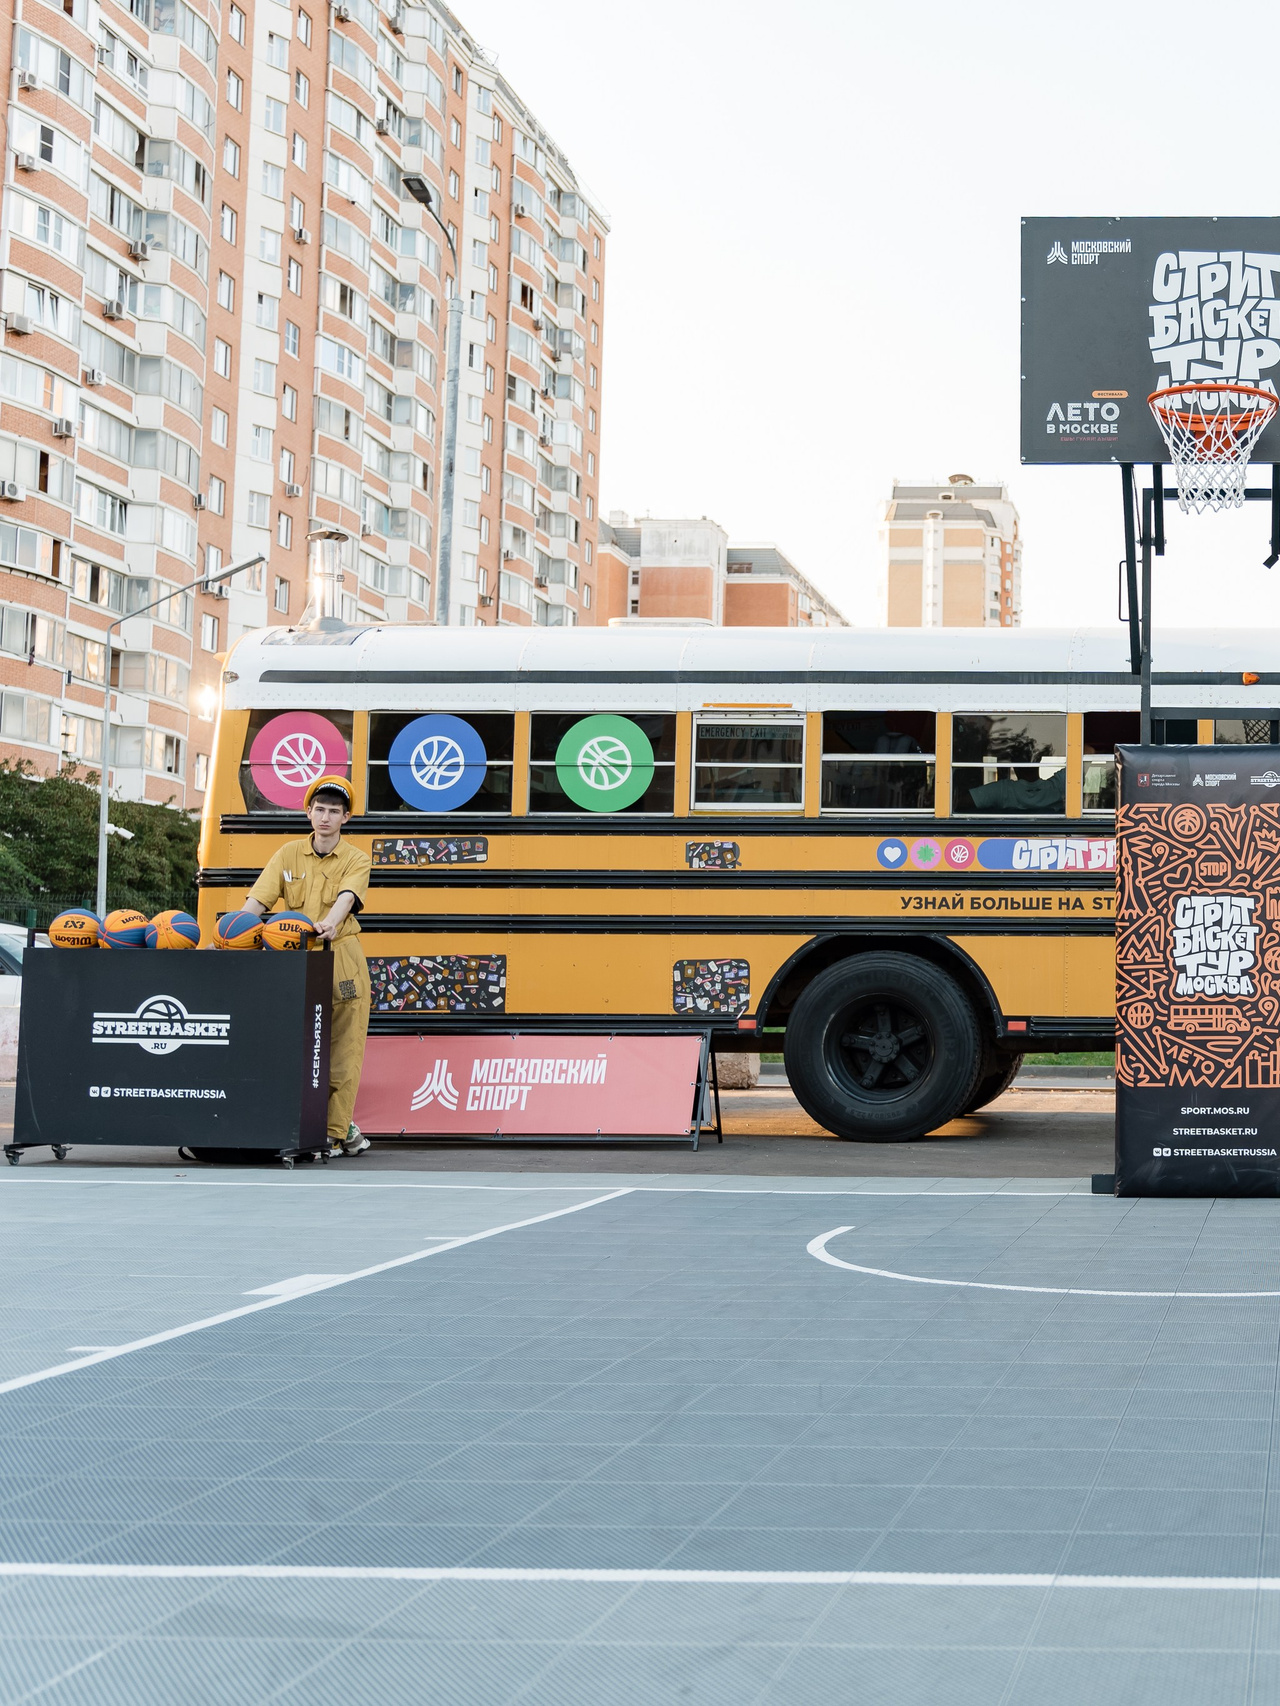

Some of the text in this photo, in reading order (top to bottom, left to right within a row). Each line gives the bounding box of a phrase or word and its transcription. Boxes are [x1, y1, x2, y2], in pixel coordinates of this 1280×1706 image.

[1071, 239, 1132, 253] МОСКОВСКИЙ
[1071, 253, 1100, 265] СПОРТ
[1046, 402, 1120, 422] ЛЕТО
[1046, 424, 1118, 434] В МОСКВЕ
[700, 727, 746, 737] EMERGENCY
[750, 727, 767, 738] EXIT
[1205, 773, 1237, 781] МОСКОВСКИЙ
[1012, 839, 1117, 870] СТРИТБА
[1200, 862, 1228, 877] STOP
[900, 893, 965, 910] УЗНАЙ
[970, 897, 1052, 910] БОЛЬШЕ
[1058, 897, 1085, 910] НА
[1092, 896, 1115, 910] ST
[1175, 896, 1255, 930] СТРИТ
[279, 922, 308, 933] Wils
[55, 934, 92, 946] Wilson
[1172, 924, 1260, 958] БАСКЕТ
[1175, 950, 1255, 977] ТУР
[1175, 973, 1255, 996] МОСКВА
[92, 1021, 231, 1037] STREETBASKET
[1166, 1044, 1215, 1075] ЛЕТО
[470, 1053, 608, 1085] МОСКОВСКИЙ
[113, 1087, 227, 1099] STREETBASKETRUSSIA
[465, 1085, 533, 1111] СПОРТ
[1180, 1107, 1250, 1115] SPORT.MOS.RU
[1172, 1127, 1258, 1136] STREETBASKET.RU
[1173, 1148, 1277, 1157] STREETBASKETRUSSIA
